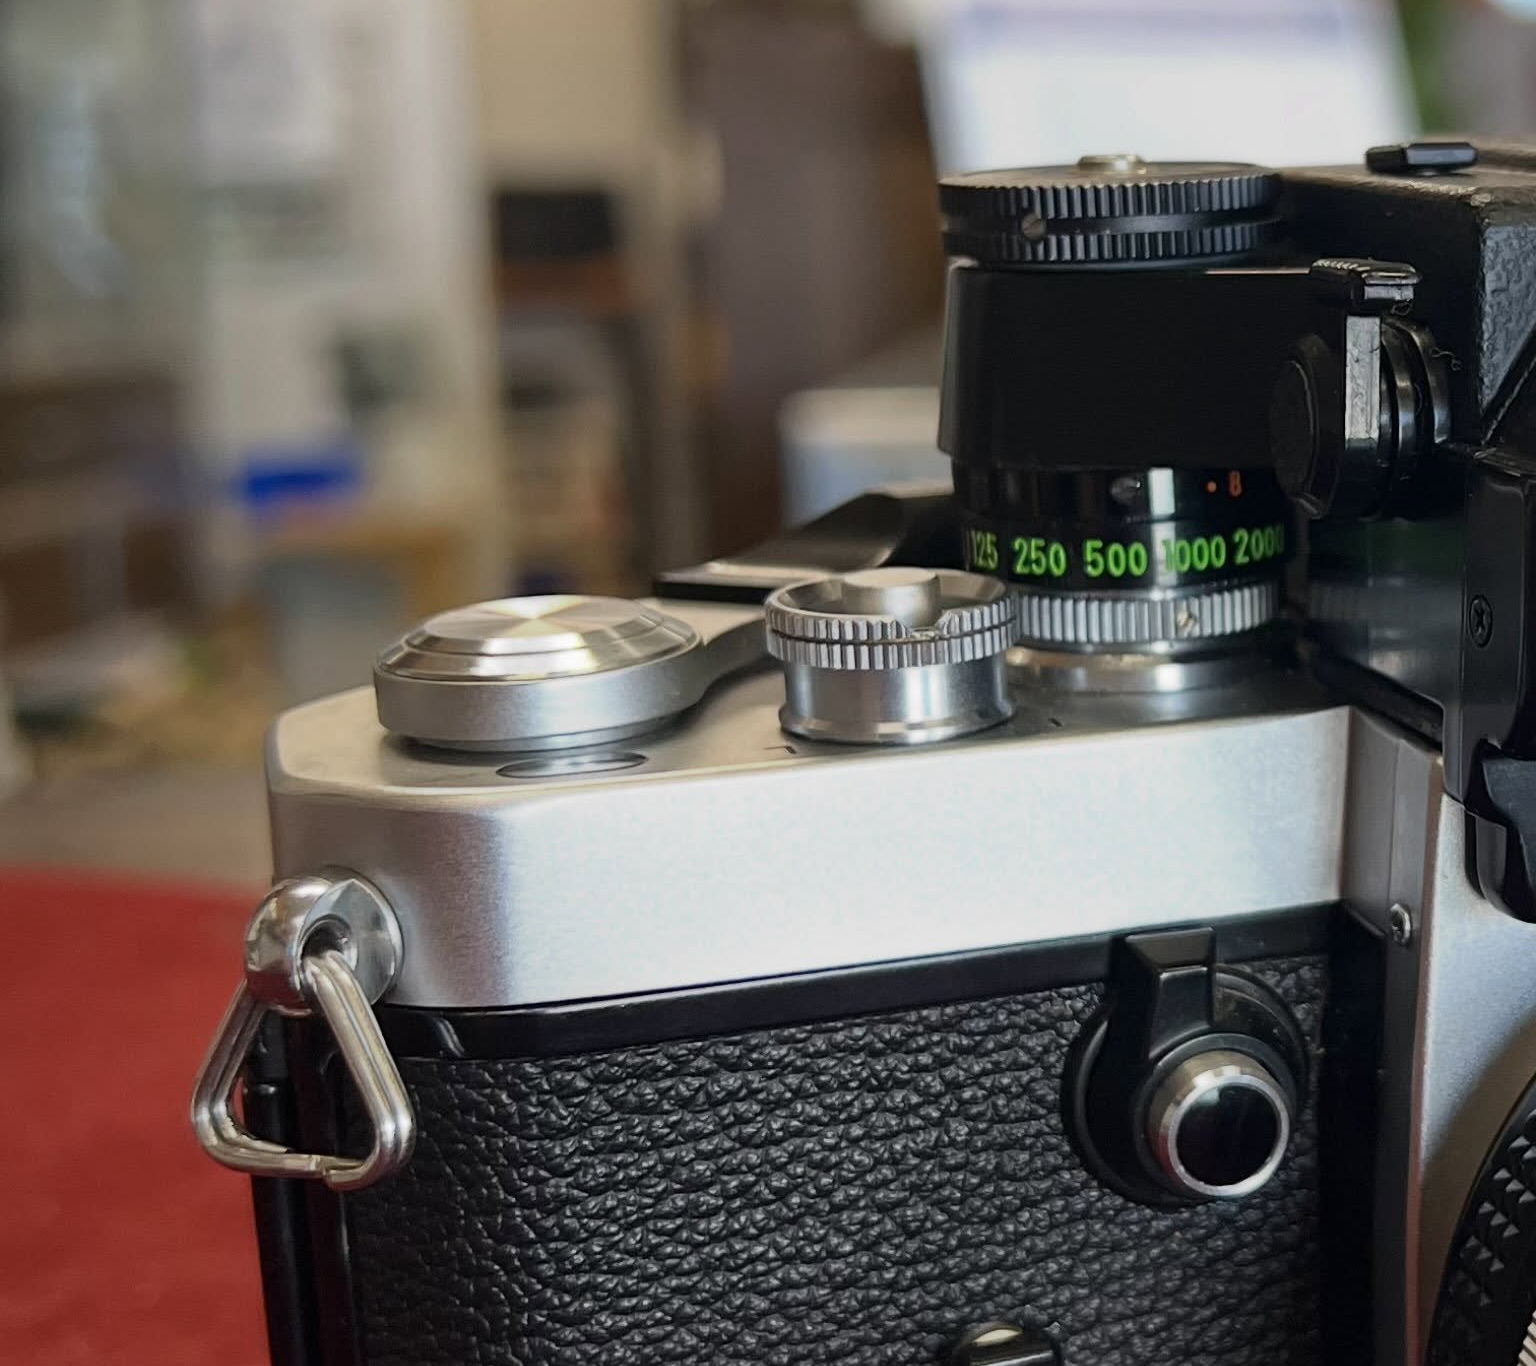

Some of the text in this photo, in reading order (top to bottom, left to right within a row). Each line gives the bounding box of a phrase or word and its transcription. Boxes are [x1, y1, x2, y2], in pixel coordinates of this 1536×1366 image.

[1012, 537, 1067, 577] 250
[1083, 539, 1147, 578] 500
[1163, 534, 1226, 575] 1000
